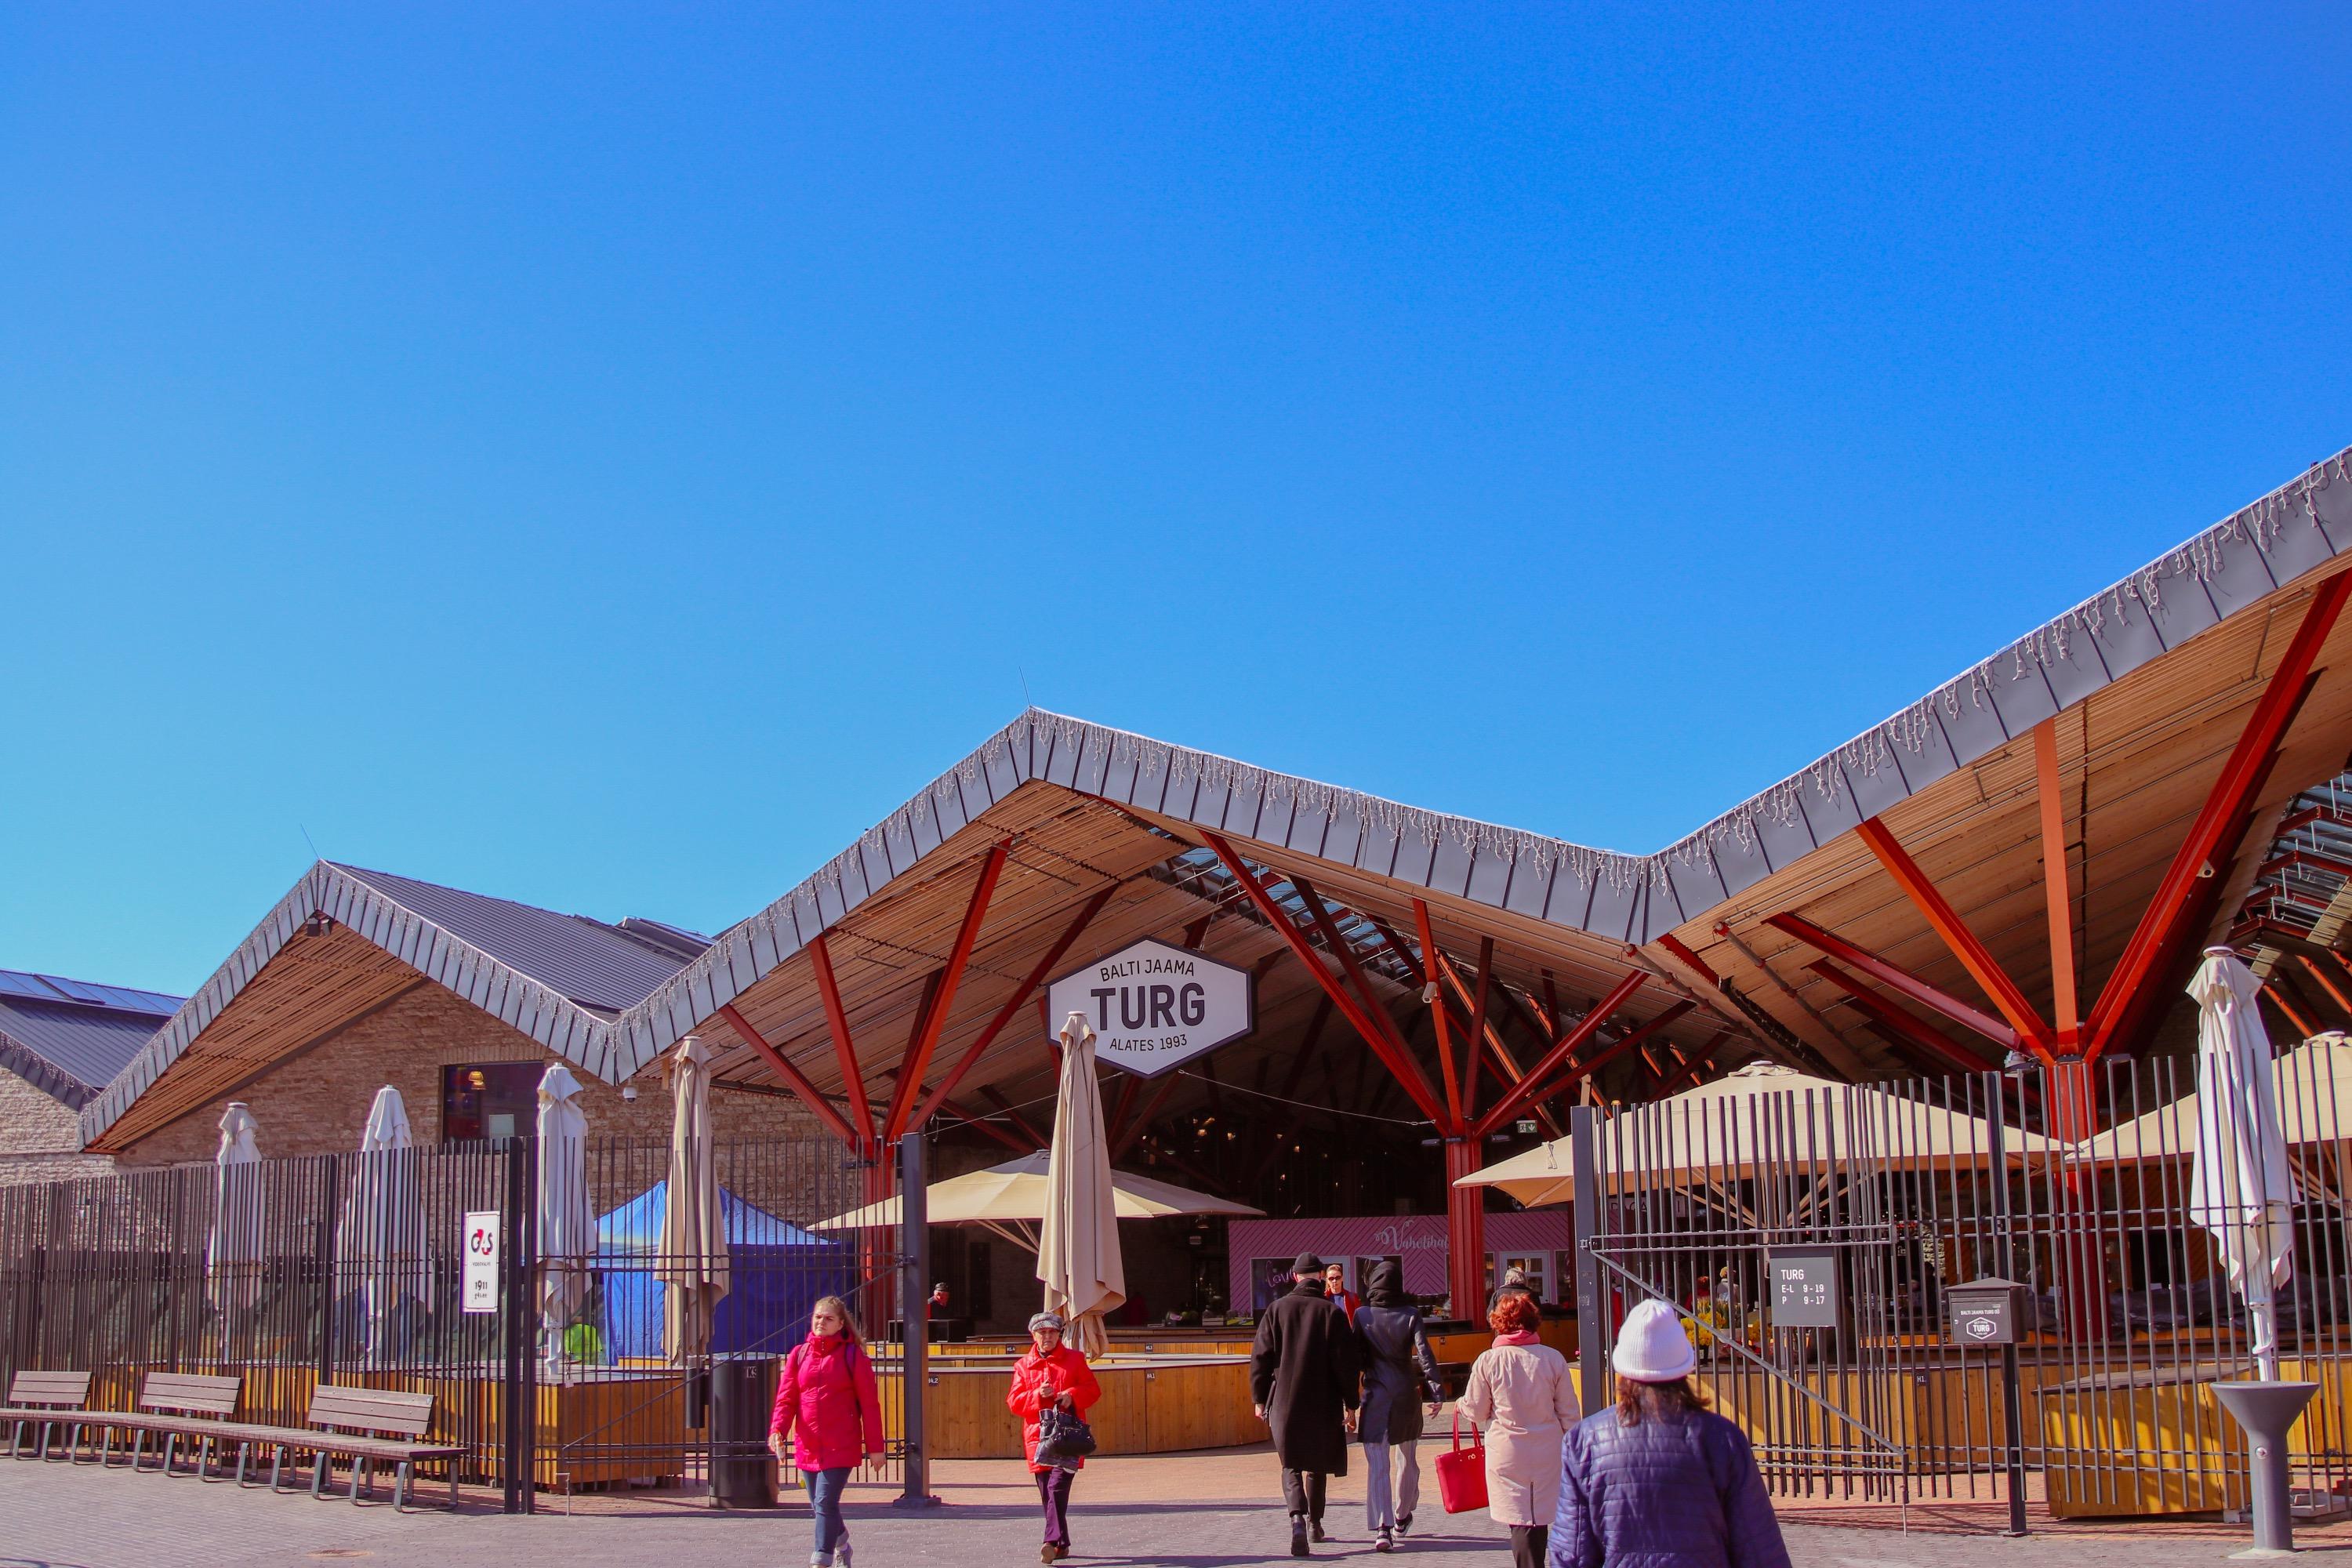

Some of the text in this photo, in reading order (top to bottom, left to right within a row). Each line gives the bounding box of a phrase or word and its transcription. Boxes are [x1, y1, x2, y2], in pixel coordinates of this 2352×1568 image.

[1100, 959, 1194, 982] BALTI JAAMA
[1091, 982, 1205, 1031] TURG
[1109, 1034, 1188, 1051] ALATES 1993
[1780, 1269, 1805, 1280] TURG
[475, 1279, 488, 1290] 1911
[1781, 1284, 1794, 1293] E-L
[1803, 1284, 1808, 1293] 9
[1815, 1283, 1824, 1293] 19
[1782, 1296, 1787, 1305] P
[1804, 1296, 1809, 1305] 9
[1816, 1296, 1825, 1305] 17
